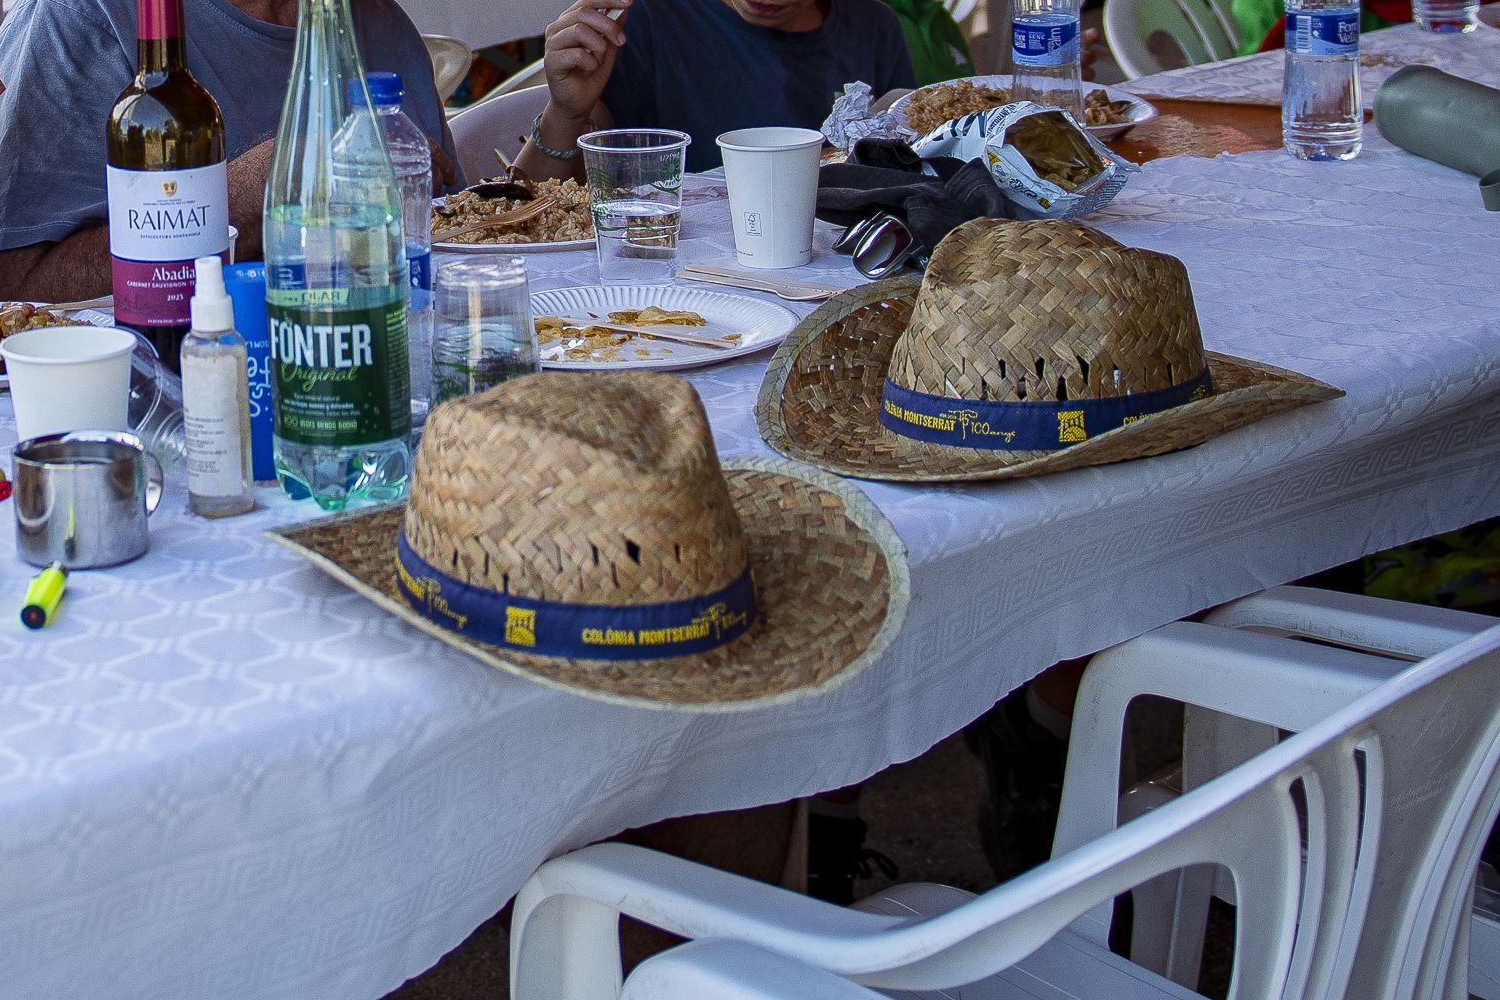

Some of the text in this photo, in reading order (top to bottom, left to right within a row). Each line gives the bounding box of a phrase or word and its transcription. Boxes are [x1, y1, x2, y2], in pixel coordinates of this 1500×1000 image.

[128, 205, 210, 230] RAIMAT
[152, 266, 196, 281] Abadia
[270, 317, 373, 369] FONTER
[281, 364, 357, 392] Original
[903, 409, 956, 432] MONTSERRAT
